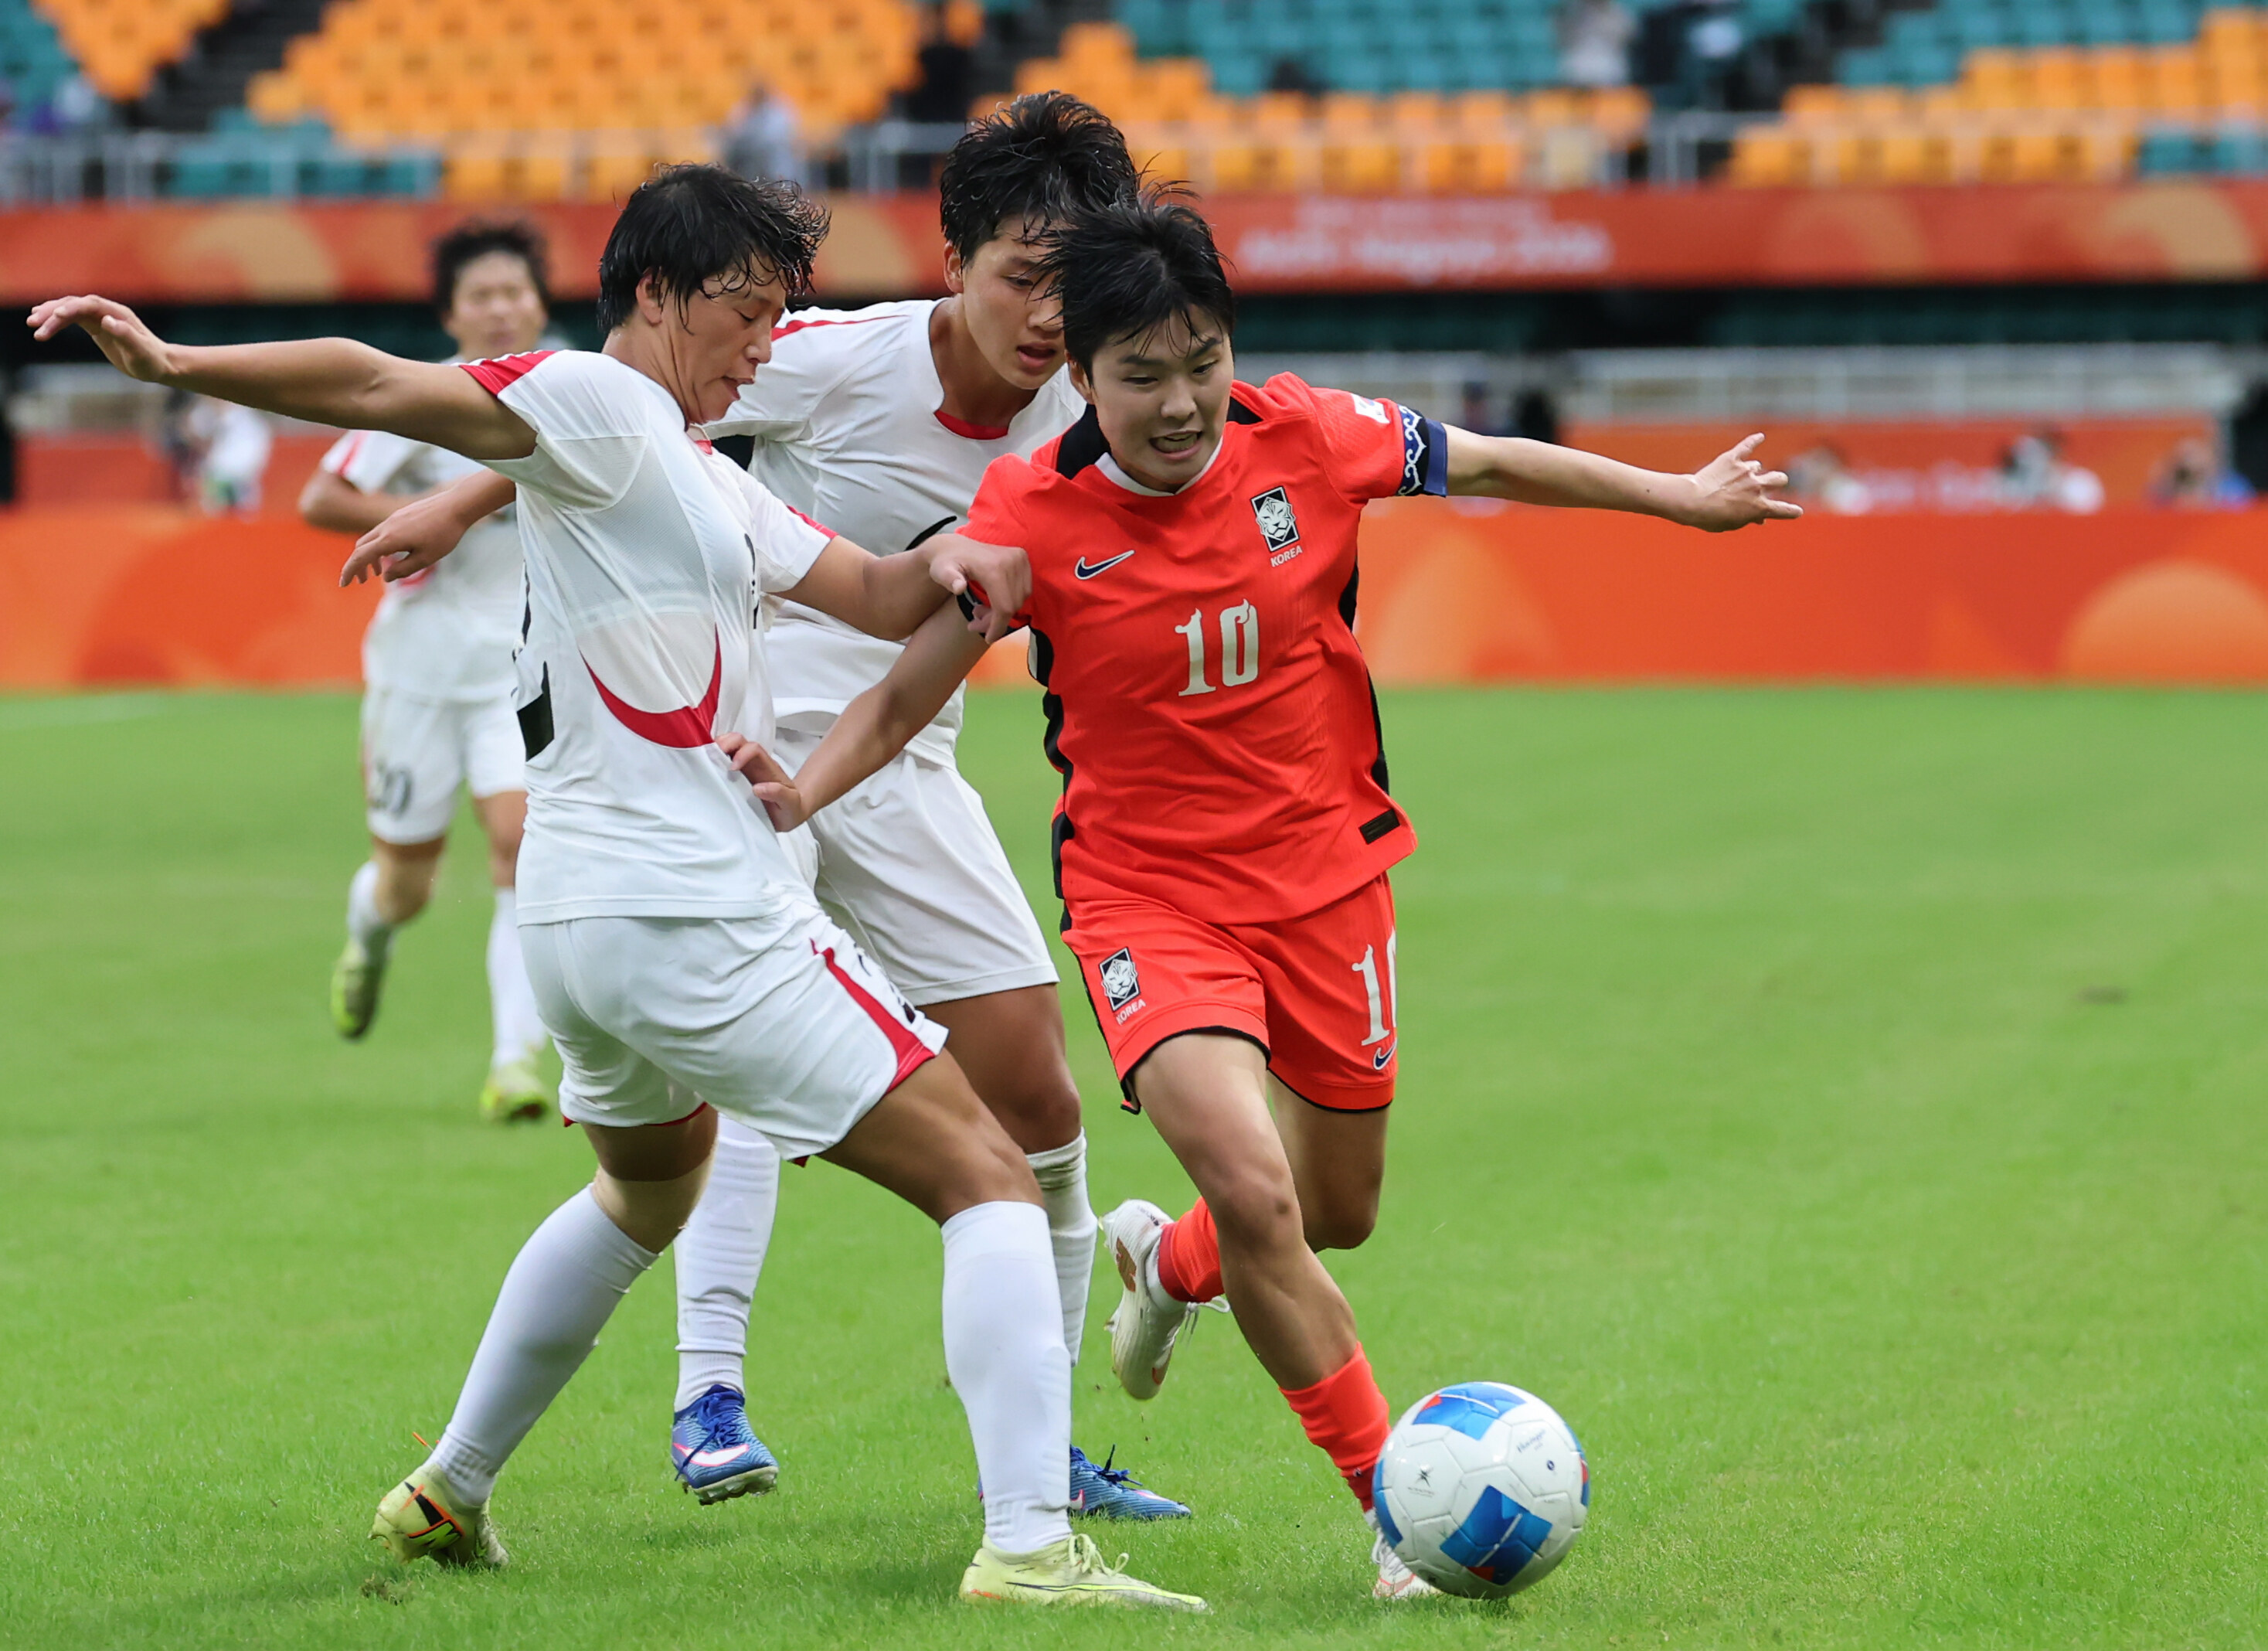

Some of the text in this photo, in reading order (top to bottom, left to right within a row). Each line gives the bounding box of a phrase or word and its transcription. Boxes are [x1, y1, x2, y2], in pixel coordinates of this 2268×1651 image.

[1270, 545, 1303, 567] KOREA
[1175, 598, 1259, 696] 10
[1115, 999, 1146, 1026] KOREA
